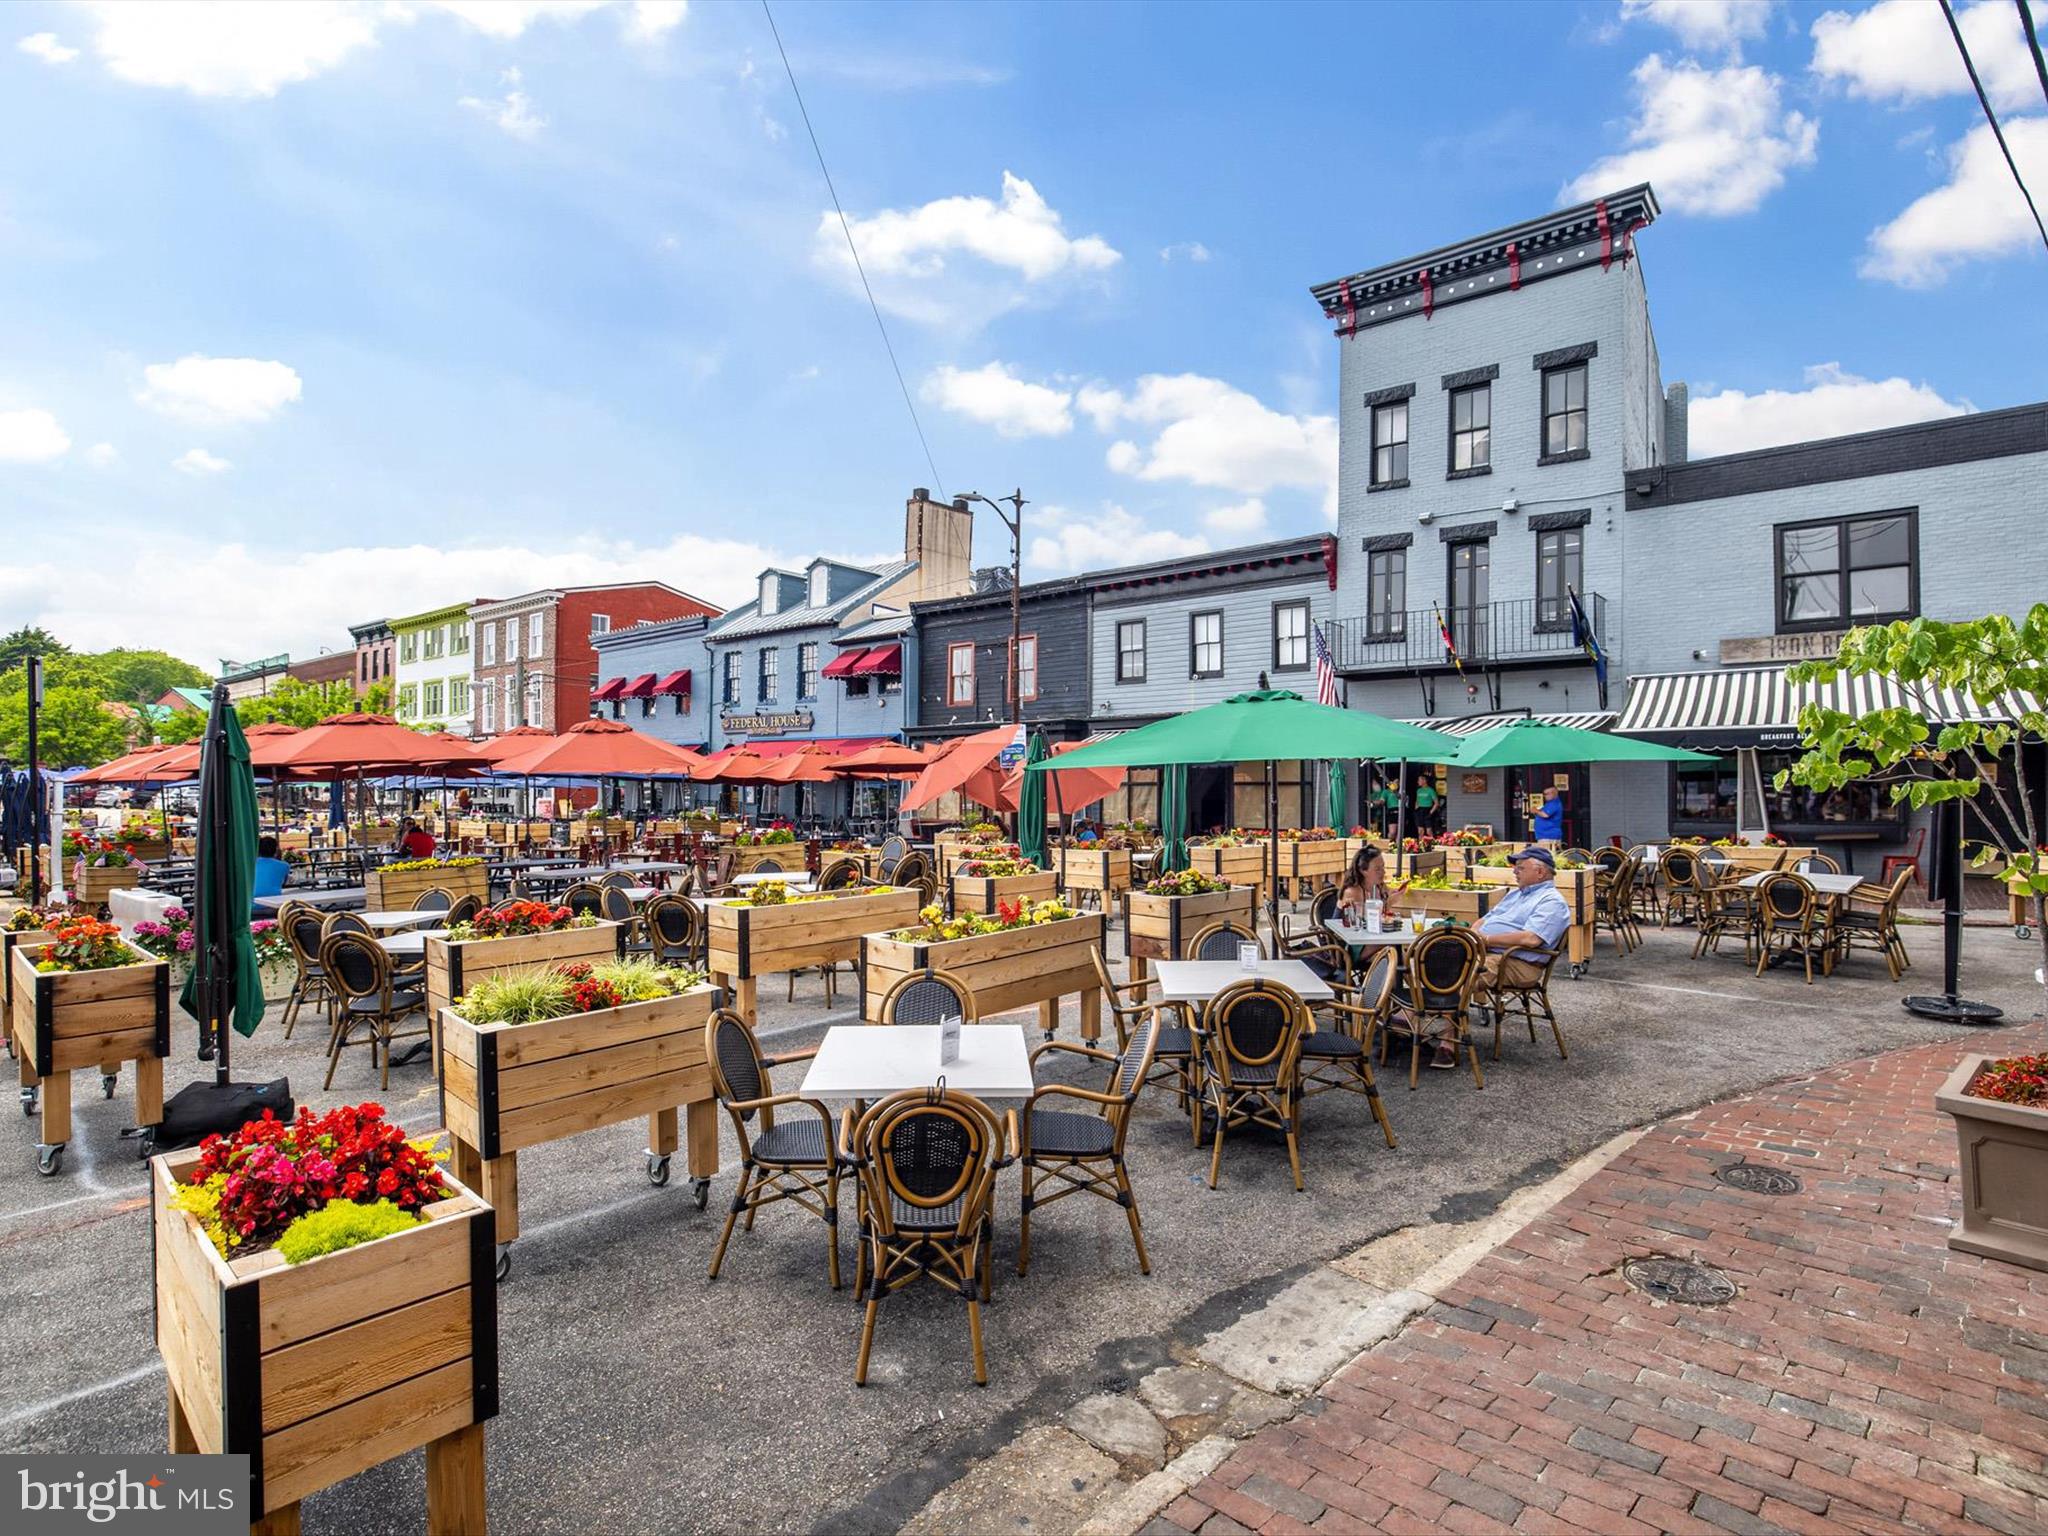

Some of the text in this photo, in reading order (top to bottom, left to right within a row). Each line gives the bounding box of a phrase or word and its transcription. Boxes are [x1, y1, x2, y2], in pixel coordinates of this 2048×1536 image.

[1770, 636, 1814, 658] IRON
[1467, 696, 1476, 704] 14
[730, 715, 801, 729] FEDERAL HOUSE
[1760, 732, 1795, 741] BREAKFAST
